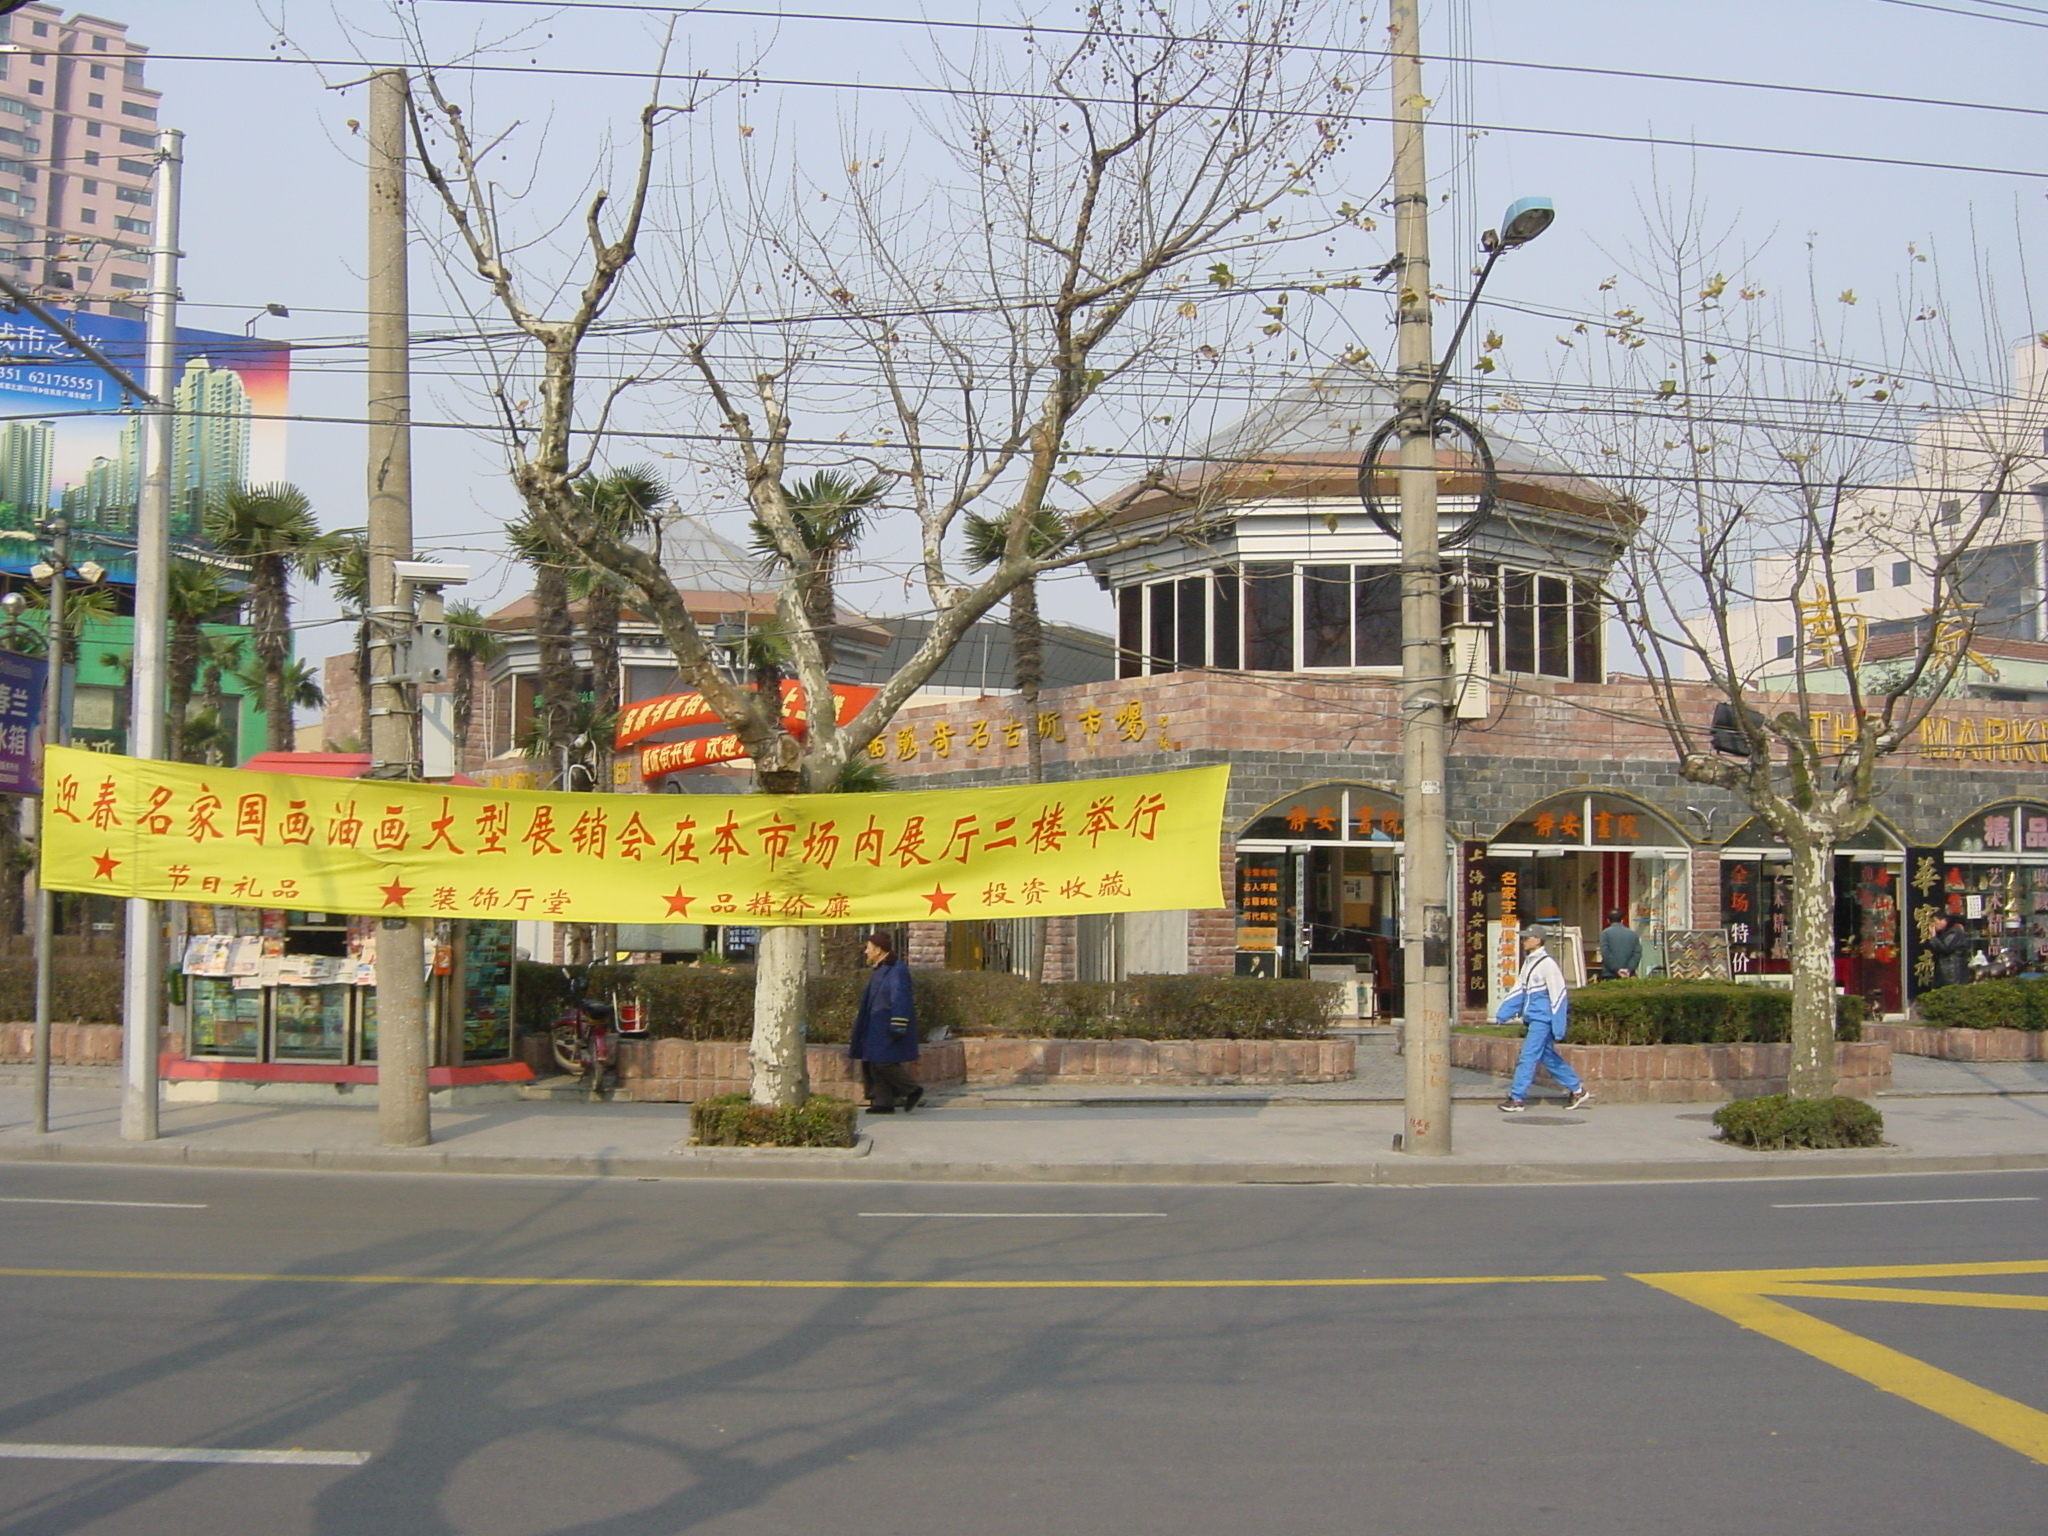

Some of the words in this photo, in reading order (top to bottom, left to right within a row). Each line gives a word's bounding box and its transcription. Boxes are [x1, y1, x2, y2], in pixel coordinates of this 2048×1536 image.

[28, 371, 94, 391] 62175555
[1808, 711, 1883, 755] TH
[53, 773, 1167, 873] 迎春名家国画油画大型展销会在本市场内展厅二楼举行
[167, 864, 301, 900] 节日礼品
[430, 886, 572, 916] 装饰厅堂
[709, 890, 851, 919] 品精价廉
[981, 870, 1132, 906] 投资收藏
